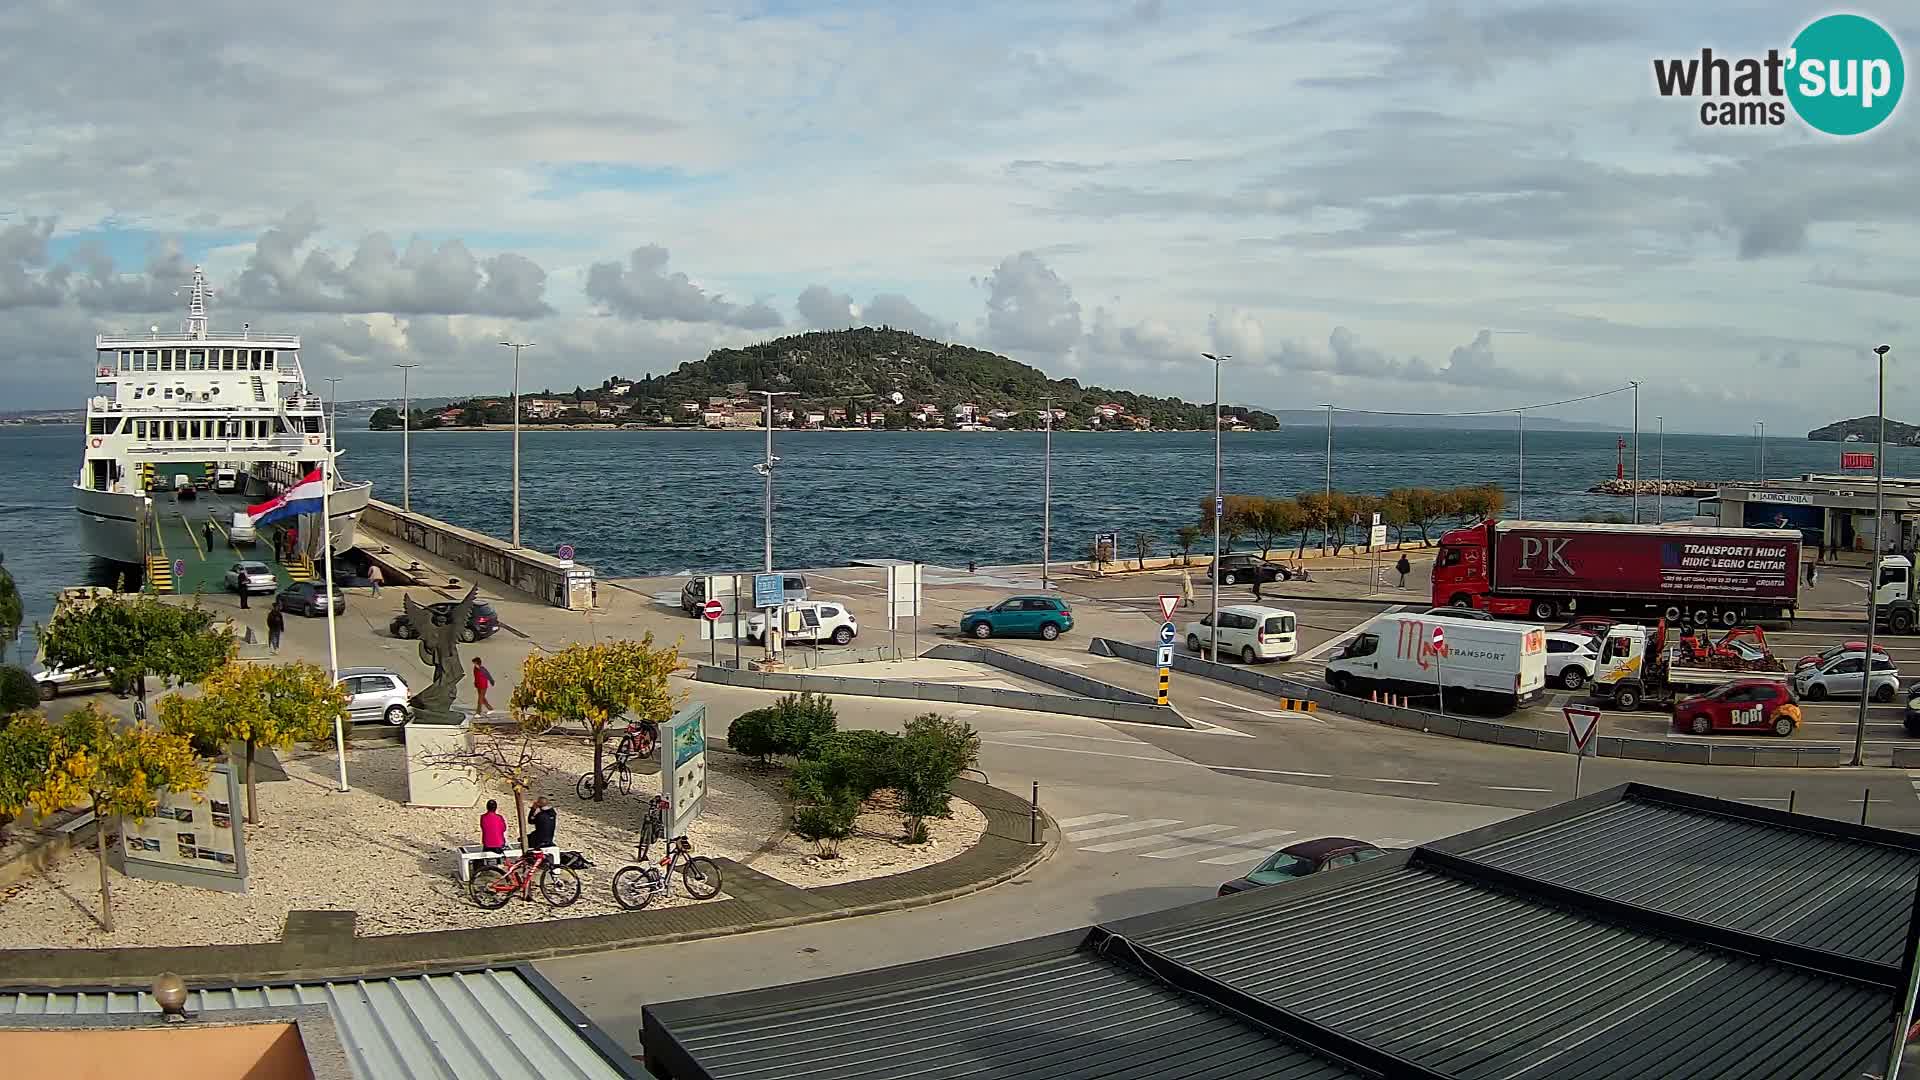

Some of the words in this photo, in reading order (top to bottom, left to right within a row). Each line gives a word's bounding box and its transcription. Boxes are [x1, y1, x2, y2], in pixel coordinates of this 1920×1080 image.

[1519, 536, 1576, 575] PK
[1684, 544, 1753, 556] TRANSPORTI
[1711, 558, 1745, 569] LEGNO
[1746, 560, 1786, 570] CENTAR
[1449, 648, 1506, 661] TRANSPORT
